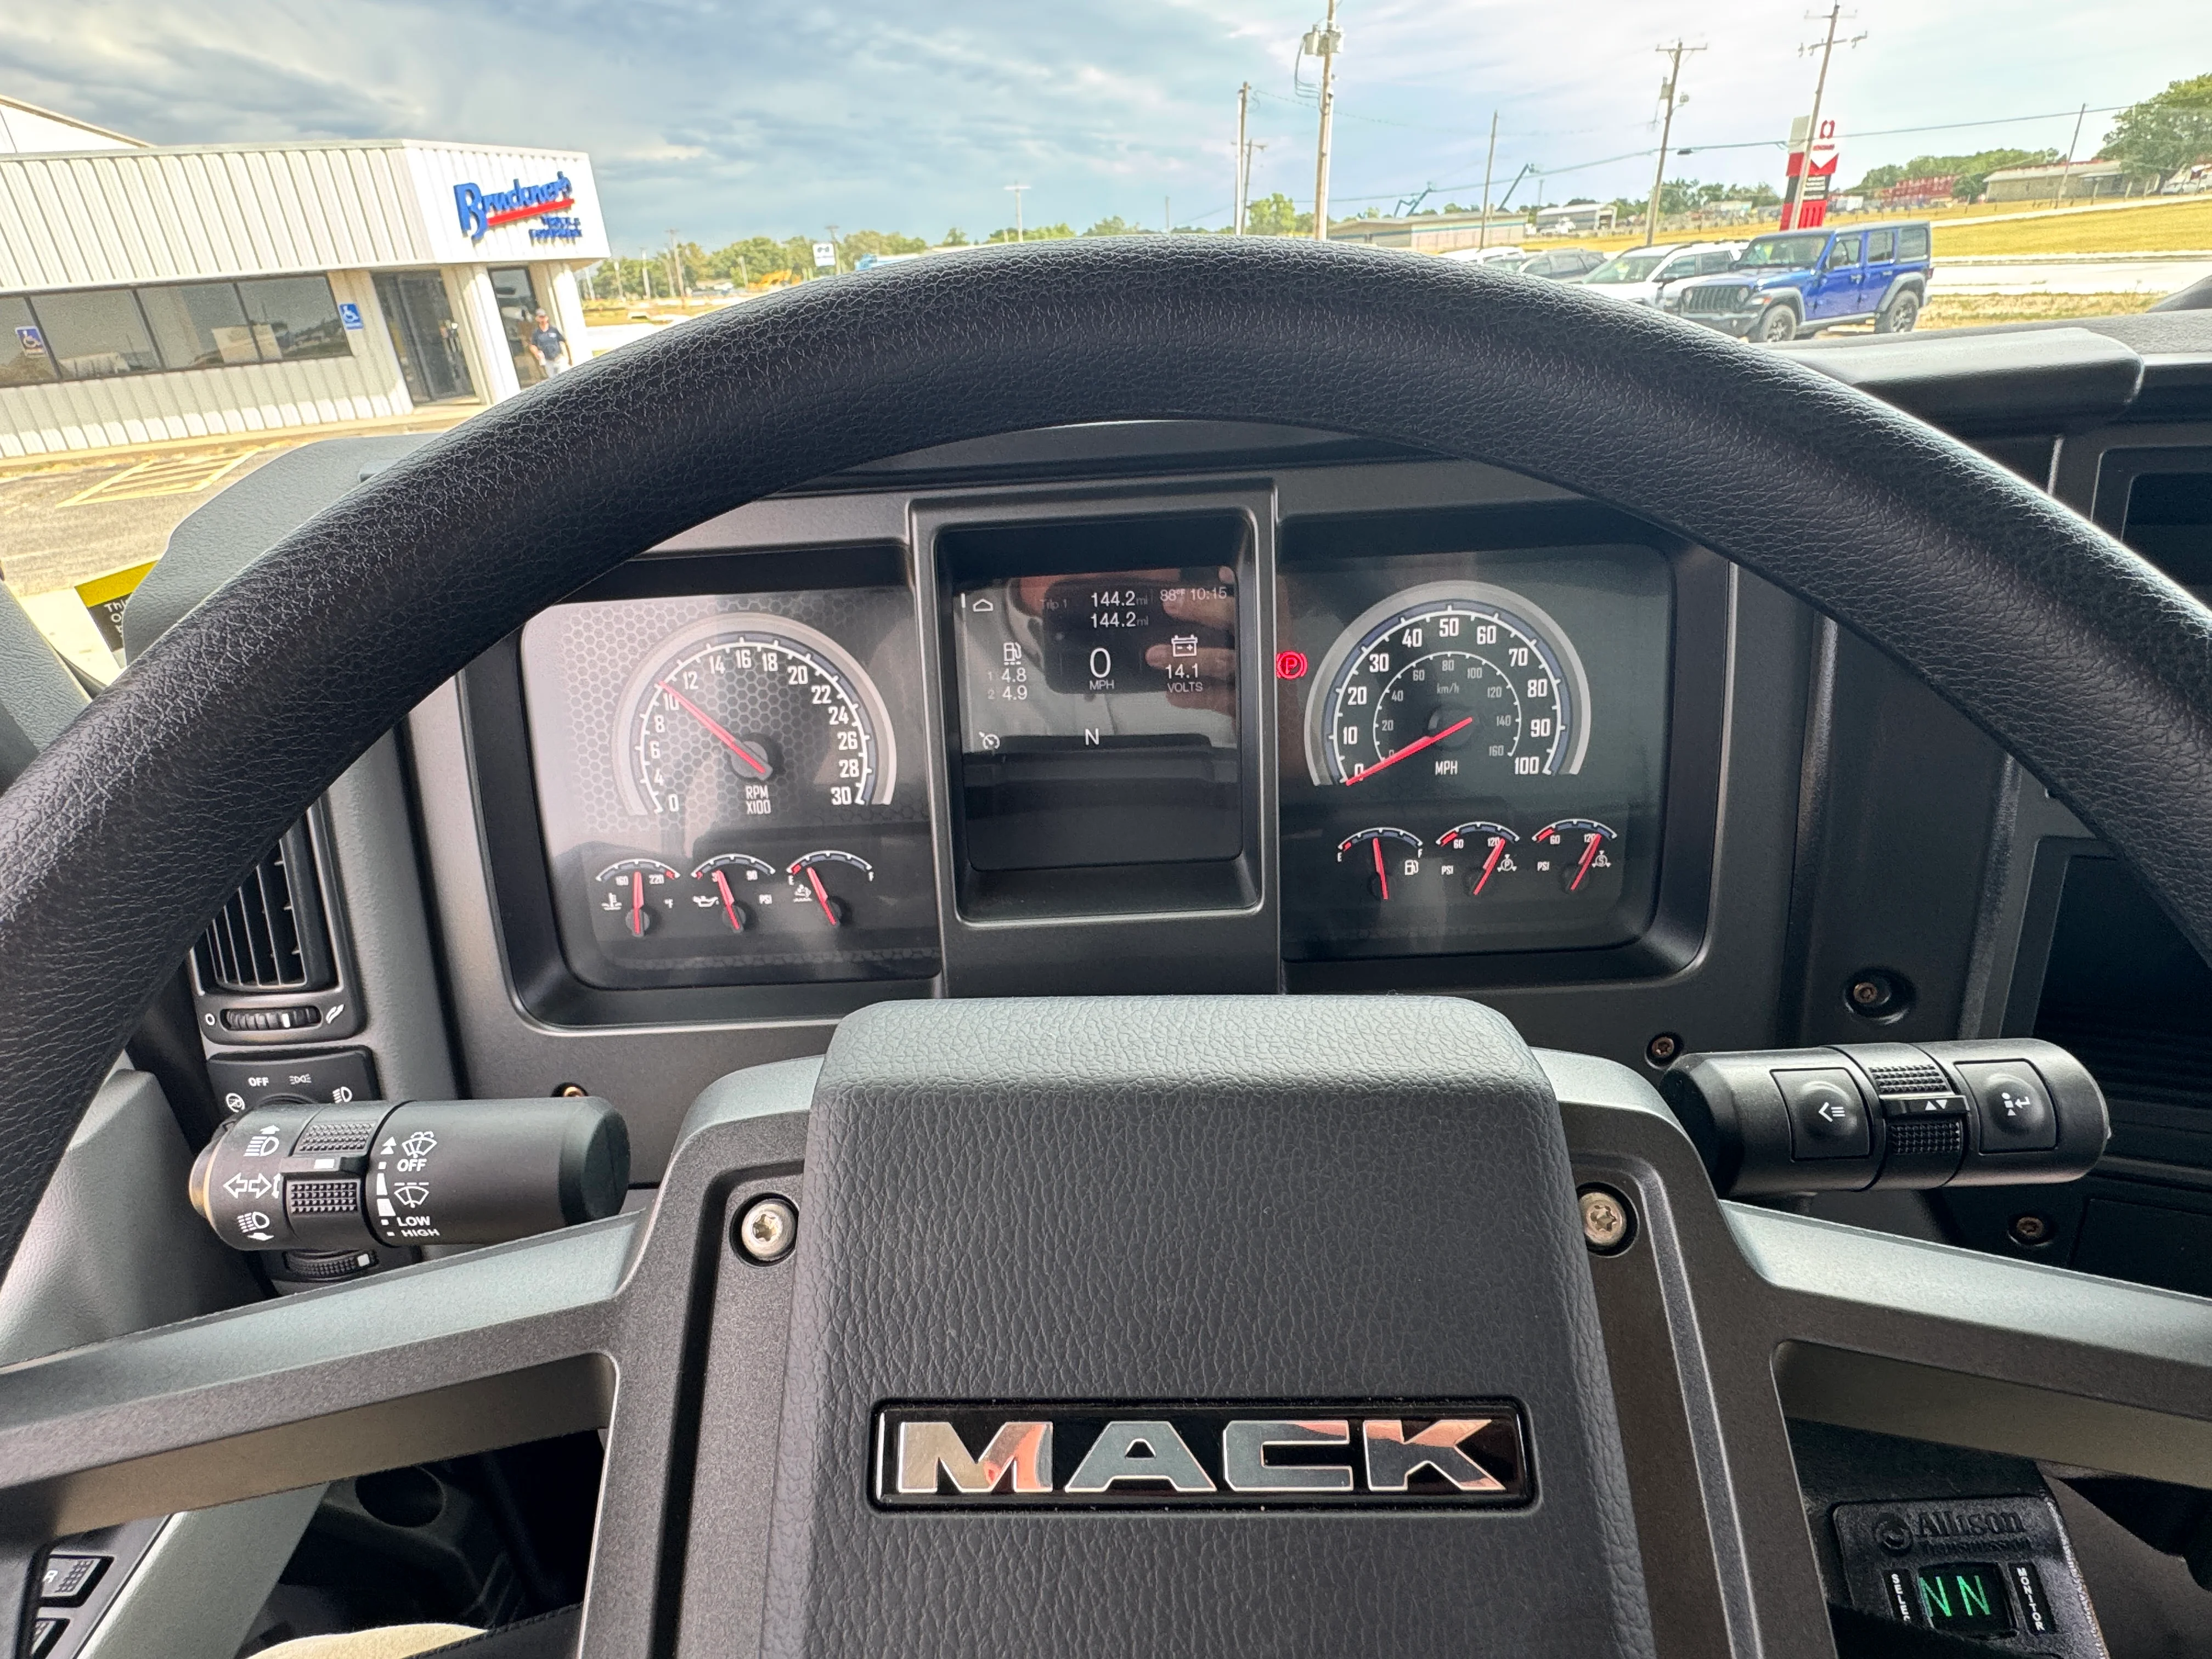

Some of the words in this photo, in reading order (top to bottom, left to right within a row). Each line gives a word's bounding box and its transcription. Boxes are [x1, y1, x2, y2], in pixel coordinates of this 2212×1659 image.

[1190, 586, 1227, 601] 10:15
[1439, 617, 1459, 637] 50
[1476, 625, 1497, 645] 60
[1402, 628, 1422, 648] 40
[710, 655, 725, 674] 14
[736, 650, 752, 668] 16
[762, 653, 778, 672] 18
[1090, 648, 1111, 678] 0
[1369, 653, 1389, 673] 30
[1509, 647, 1528, 667] 70
[1165, 663, 1199, 679] 14.1
[1442, 660, 1454, 672] 80
[1468, 667, 1482, 679] 100
[683, 671, 699, 690] 12
[787, 665, 809, 685] 20
[1002, 667, 1026, 682] 4.8
[1413, 670, 1425, 681] 60
[1090, 680, 1114, 690] MPH
[1167, 682, 1203, 692] VOLTS
[1437, 682, 1459, 694] km/h
[1487, 686, 1502, 698] 120
[1527, 678, 1548, 698] 80
[811, 685, 832, 704] 22
[1002, 686, 1028, 701] 4.9
[1347, 686, 1367, 706] 20
[1391, 690, 1403, 702] 40
[663, 693, 679, 711] 10
[828, 706, 849, 725] 24
[1497, 715, 1511, 726] 140
[654, 715, 665, 733] 8
[1381, 720, 1394, 731] 20
[1531, 718, 1550, 738] 90
[837, 731, 857, 751] 26
[1085, 729, 1099, 746] N
[1343, 726, 1357, 745] 10
[650, 741, 661, 759] 6
[1489, 745, 1504, 757] 160
[839, 759, 859, 778] 28
[1355, 763, 1364, 781] 0
[1435, 760, 1458, 775] MPH
[1514, 757, 1539, 775] 100
[654, 769, 664, 786] 4
[745, 785, 769, 799] RPM
[831, 786, 851, 805] 30
[668, 794, 679, 811] 0
[746, 799, 771, 815] X100
[1454, 839, 1464, 849] 60
[1488, 837, 1500, 847] 120
[1550, 834, 1560, 845] 60
[1337, 852, 1342, 864] E
[1418, 848, 1423, 859] F
[1441, 865, 1454, 875] PSI
[1537, 861, 1550, 871] PSI
[649, 874, 664, 884] 220
[788, 875, 794, 885] E
[249, 1077, 269, 1086] OFF
[397, 1159, 427, 1172] OFF
[397, 1216, 430, 1227] LOW
[400, 1229, 440, 1237] HIGH
[898, 1419, 1506, 1493] MACK
[1891, 1573, 1911, 1623] SELEC
[2016, 1567, 2045, 1632] MONITOR
